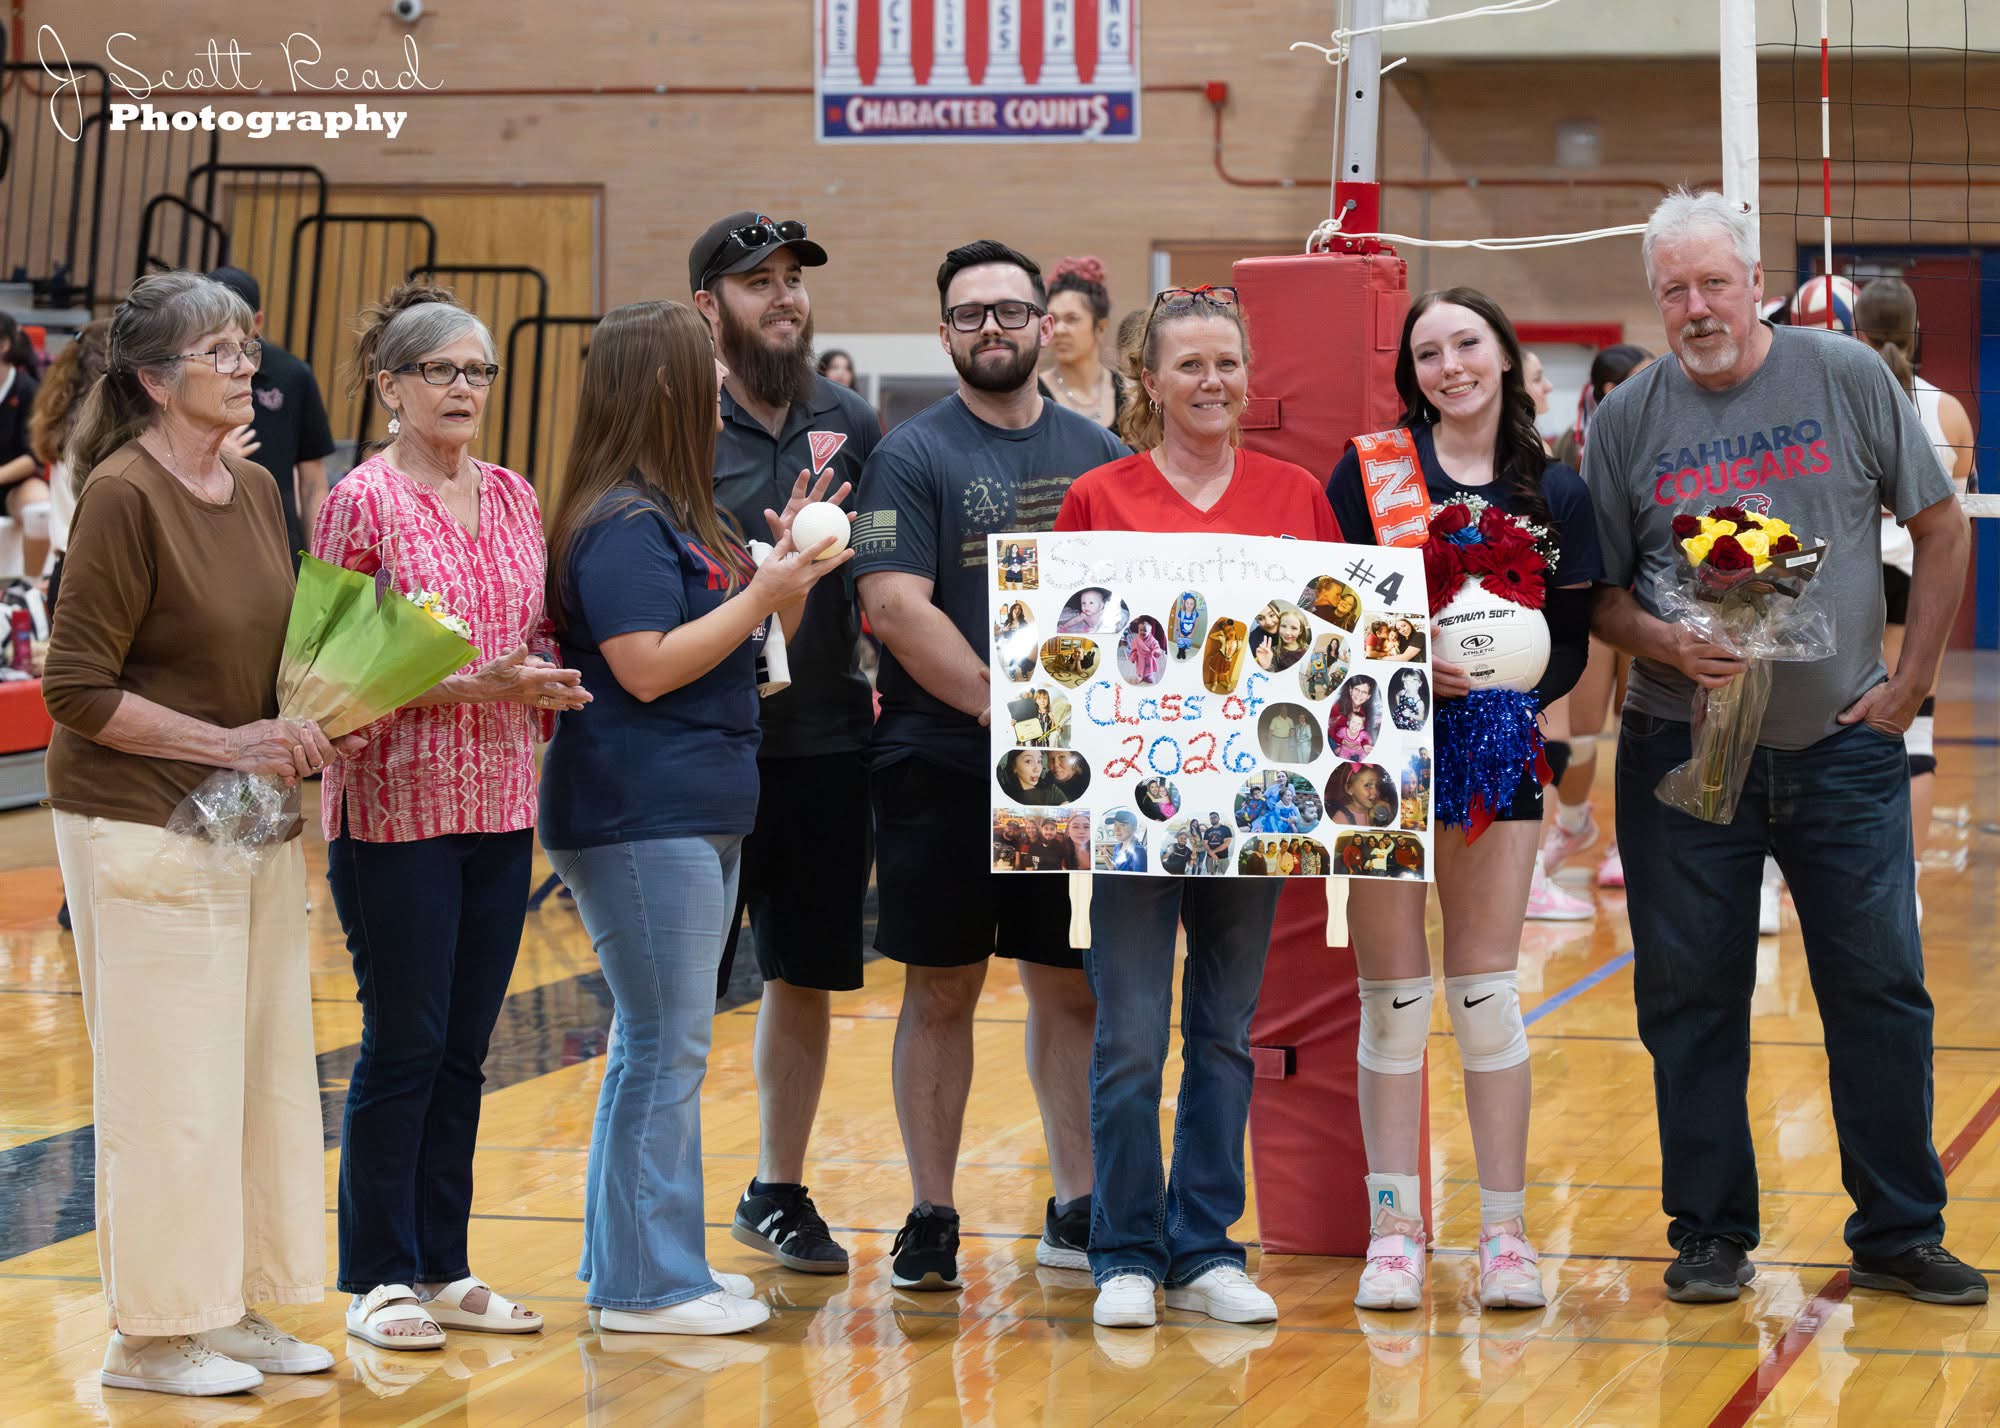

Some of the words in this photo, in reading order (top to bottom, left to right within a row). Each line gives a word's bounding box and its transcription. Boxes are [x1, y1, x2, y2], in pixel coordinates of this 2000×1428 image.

[846, 97, 997, 132] CHARACTER
[1003, 95, 1109, 135] COUNTS
[1656, 419, 1822, 475] SAHUARO
[1654, 440, 1832, 505] COUGARS
[1344, 558, 1405, 606] #4
[1437, 611, 1485, 628] PREMIUM
[1489, 609, 1516, 619] SOFT
[1222, 671, 1269, 721] of
[1103, 731, 1257, 779] 2026
